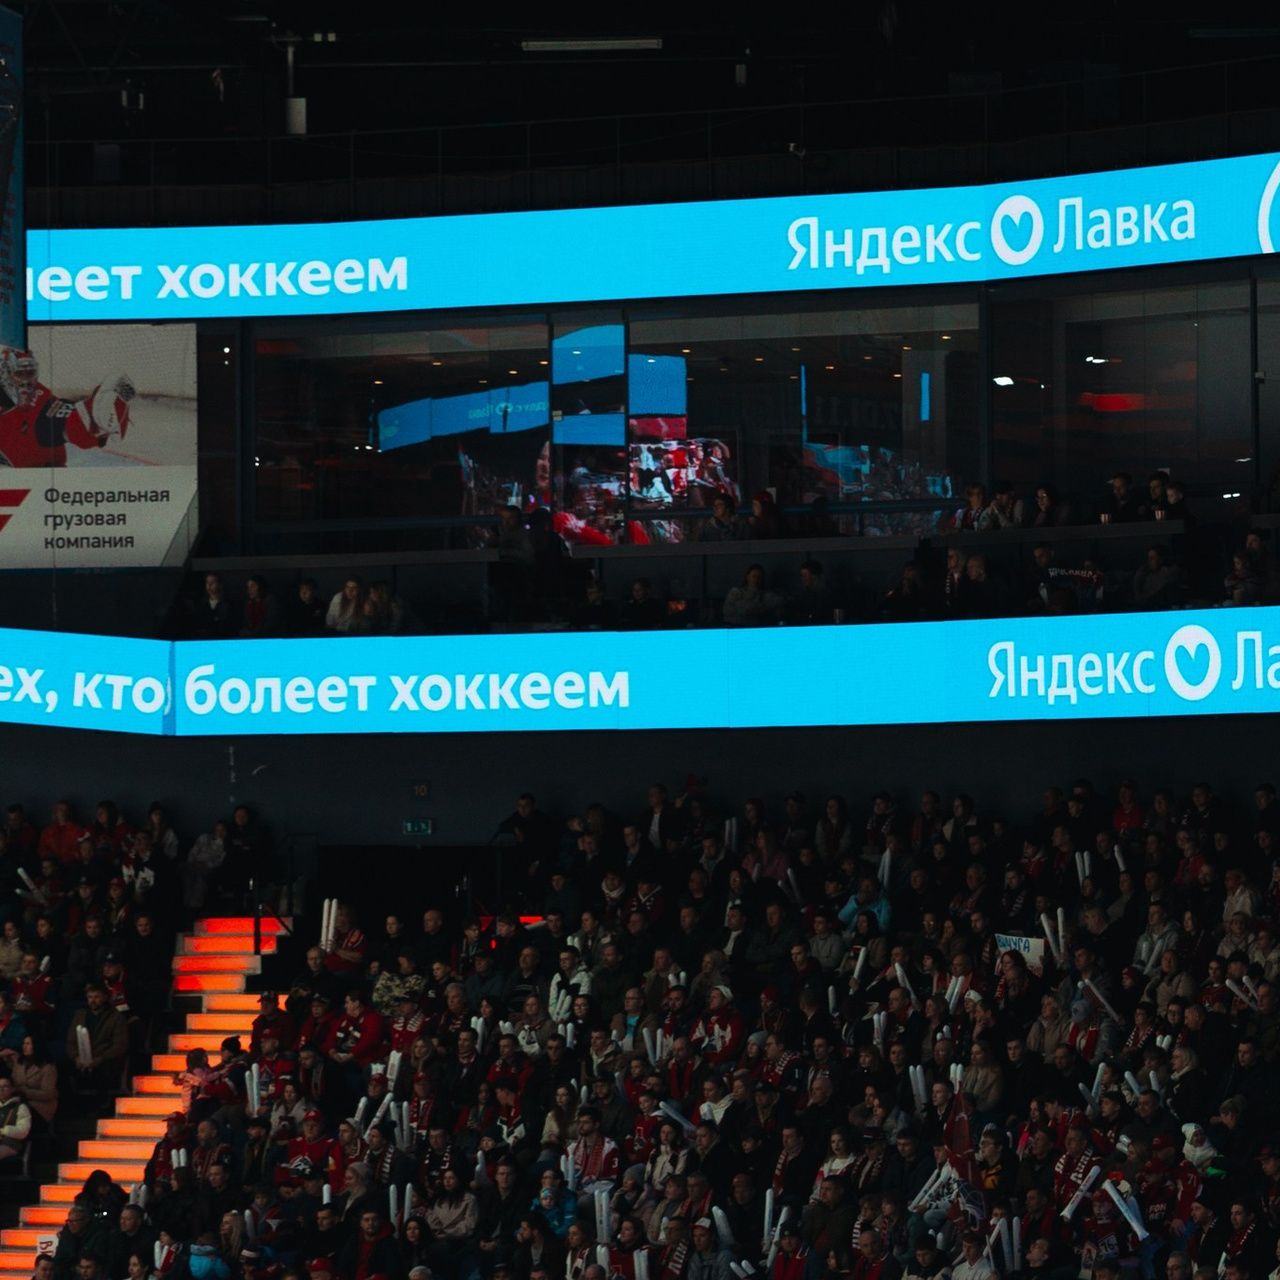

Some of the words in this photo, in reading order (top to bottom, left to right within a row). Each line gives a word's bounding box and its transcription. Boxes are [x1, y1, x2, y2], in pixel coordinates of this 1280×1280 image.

[787, 216, 981, 275] Яндекс
[1053, 197, 1195, 253] Лавка
[157, 256, 408, 299] хоккеем
[44, 488, 171, 507] Федеральная
[44, 513, 127, 530] грузовая
[44, 535, 135, 549] компания
[73, 672, 165, 713] кто
[185, 664, 377, 715] болеет
[389, 671, 629, 711] хоккеем
[988, 641, 1156, 705] Яндекс
